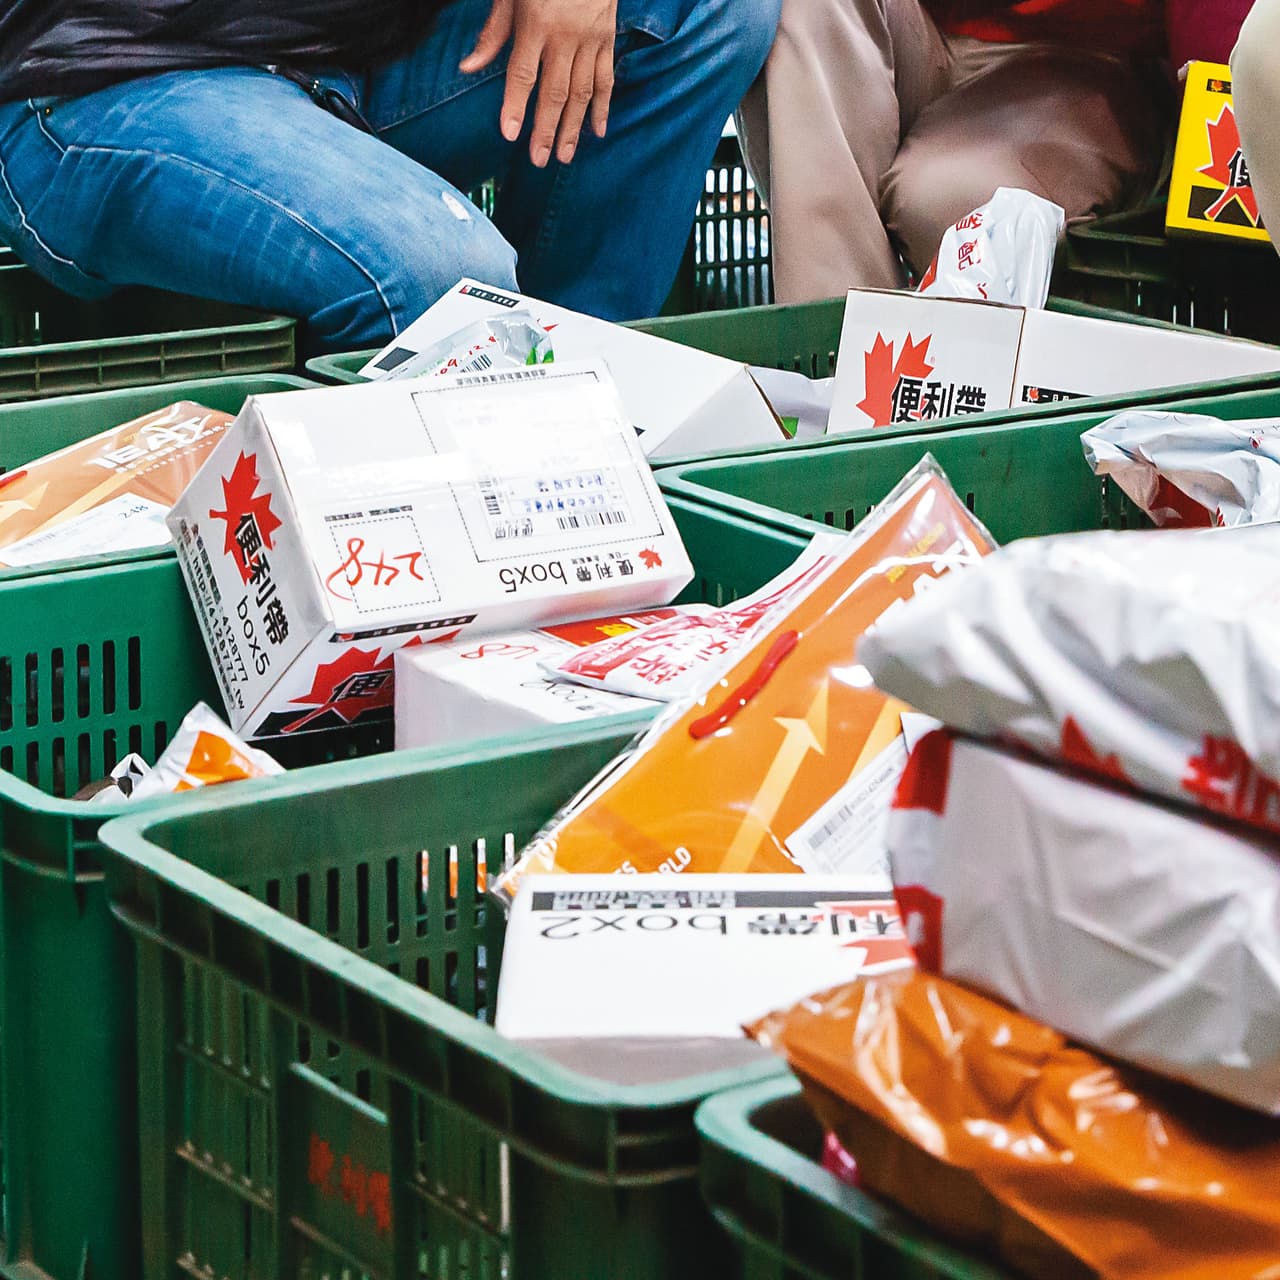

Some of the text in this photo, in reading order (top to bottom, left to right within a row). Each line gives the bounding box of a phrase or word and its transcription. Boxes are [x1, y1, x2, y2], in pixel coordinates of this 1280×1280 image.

[234, 513, 290, 646] 便利帶
[498, 558, 635, 593] 便利帶 box5
[236, 594, 271, 676] box5
[539, 911, 907, 940] 利帶 box2
